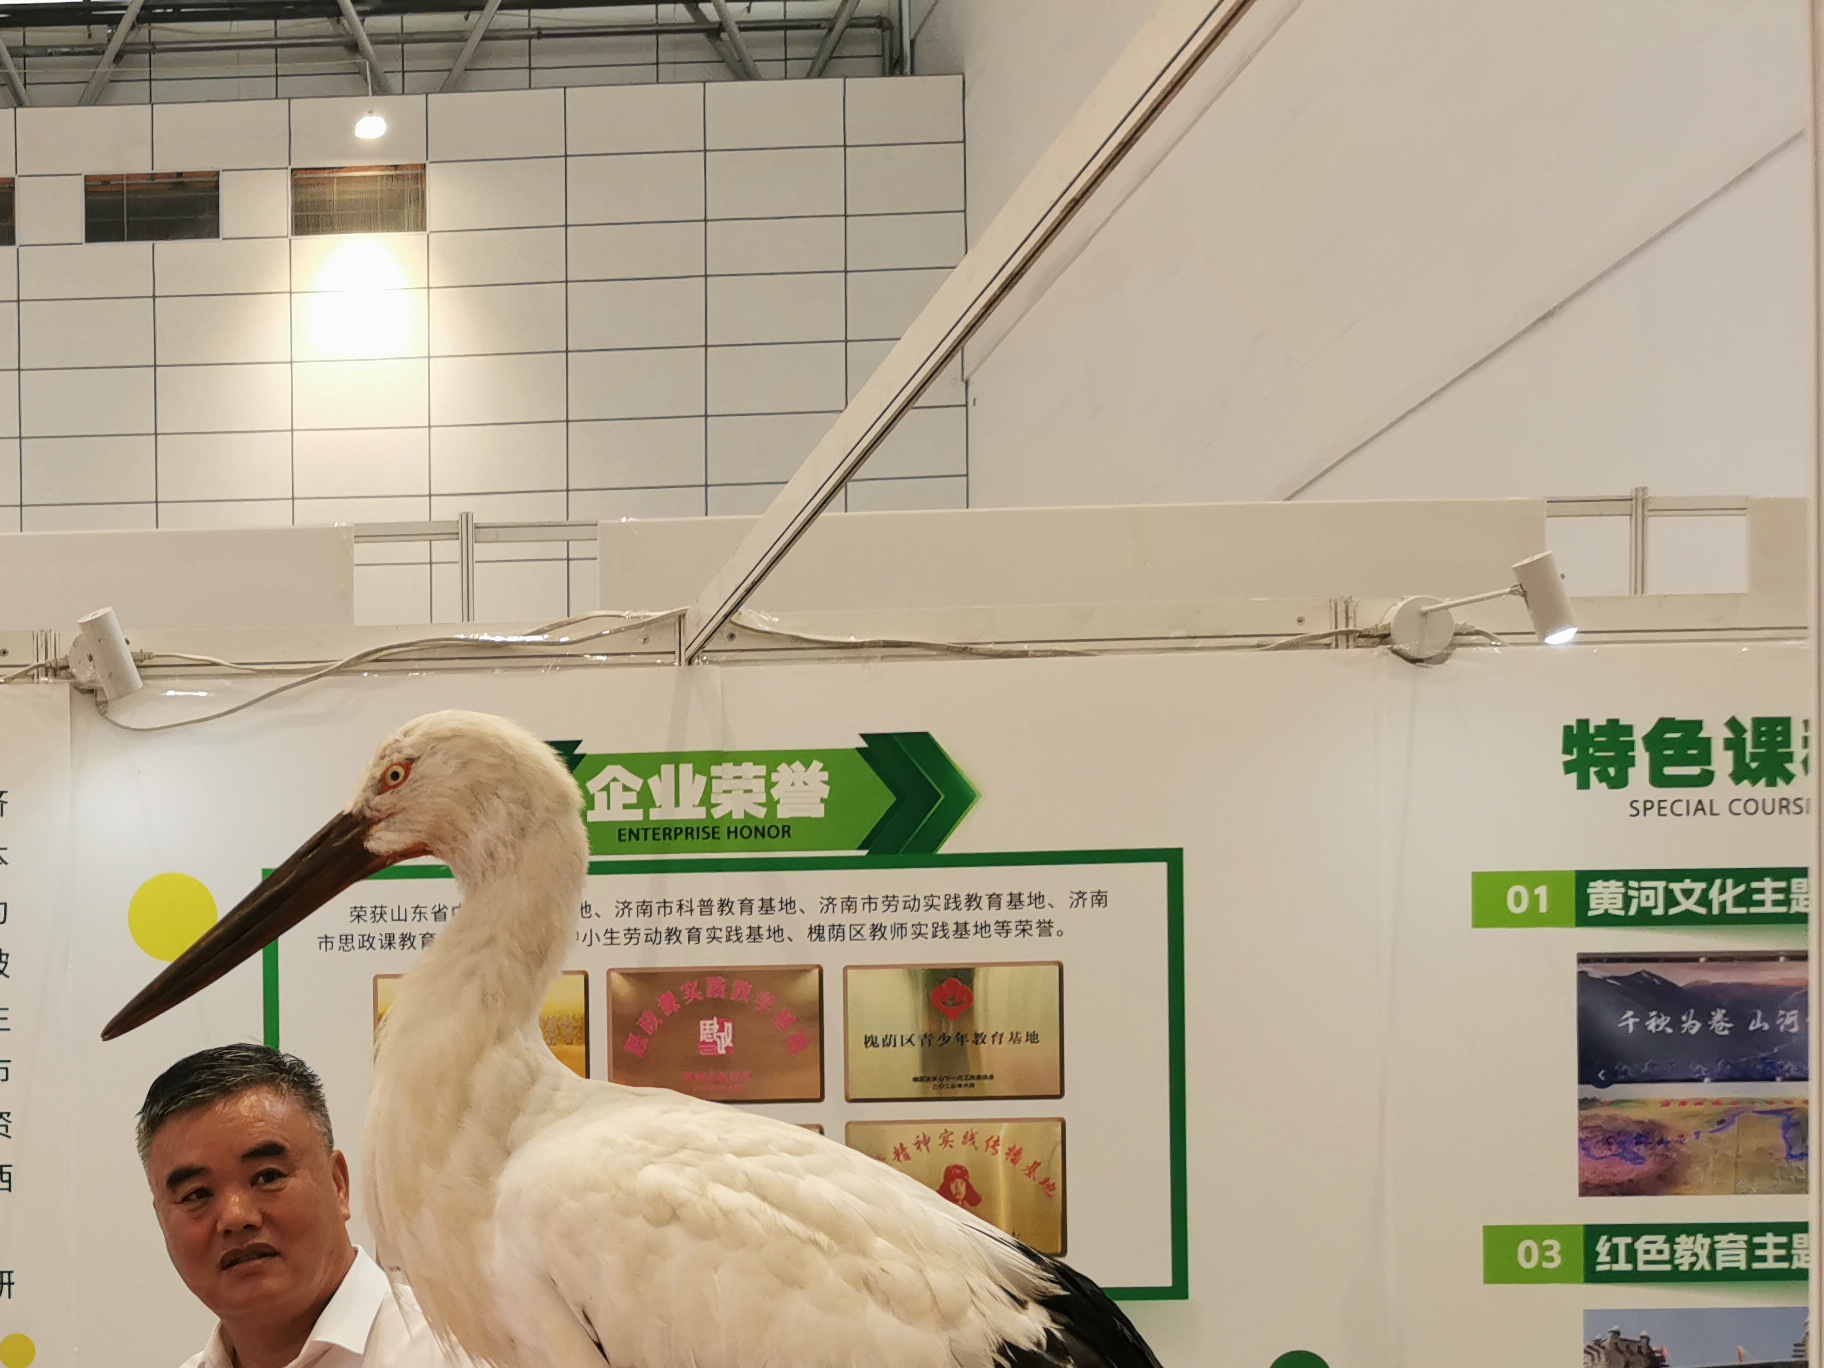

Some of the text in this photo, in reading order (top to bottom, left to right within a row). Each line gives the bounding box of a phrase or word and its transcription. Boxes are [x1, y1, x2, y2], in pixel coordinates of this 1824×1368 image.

[1562, 716, 1810, 790] 特色课
[585, 760, 831, 822] 企业荣誉
[1628, 799, 1721, 818] SPECIAL
[617, 824, 793, 842] ENTERPRISE HONOR
[1505, 885, 1549, 914] 01
[576, 919, 1064, 948] 小生劳动教育实践基地、槐荫区教师实践基地等荣誉。
[863, 1030, 1040, 1049] 槐荫区青少年教育基地
[876, 1128, 1057, 1199] 精神实践传播基地
[1516, 1238, 1562, 1270] 03
